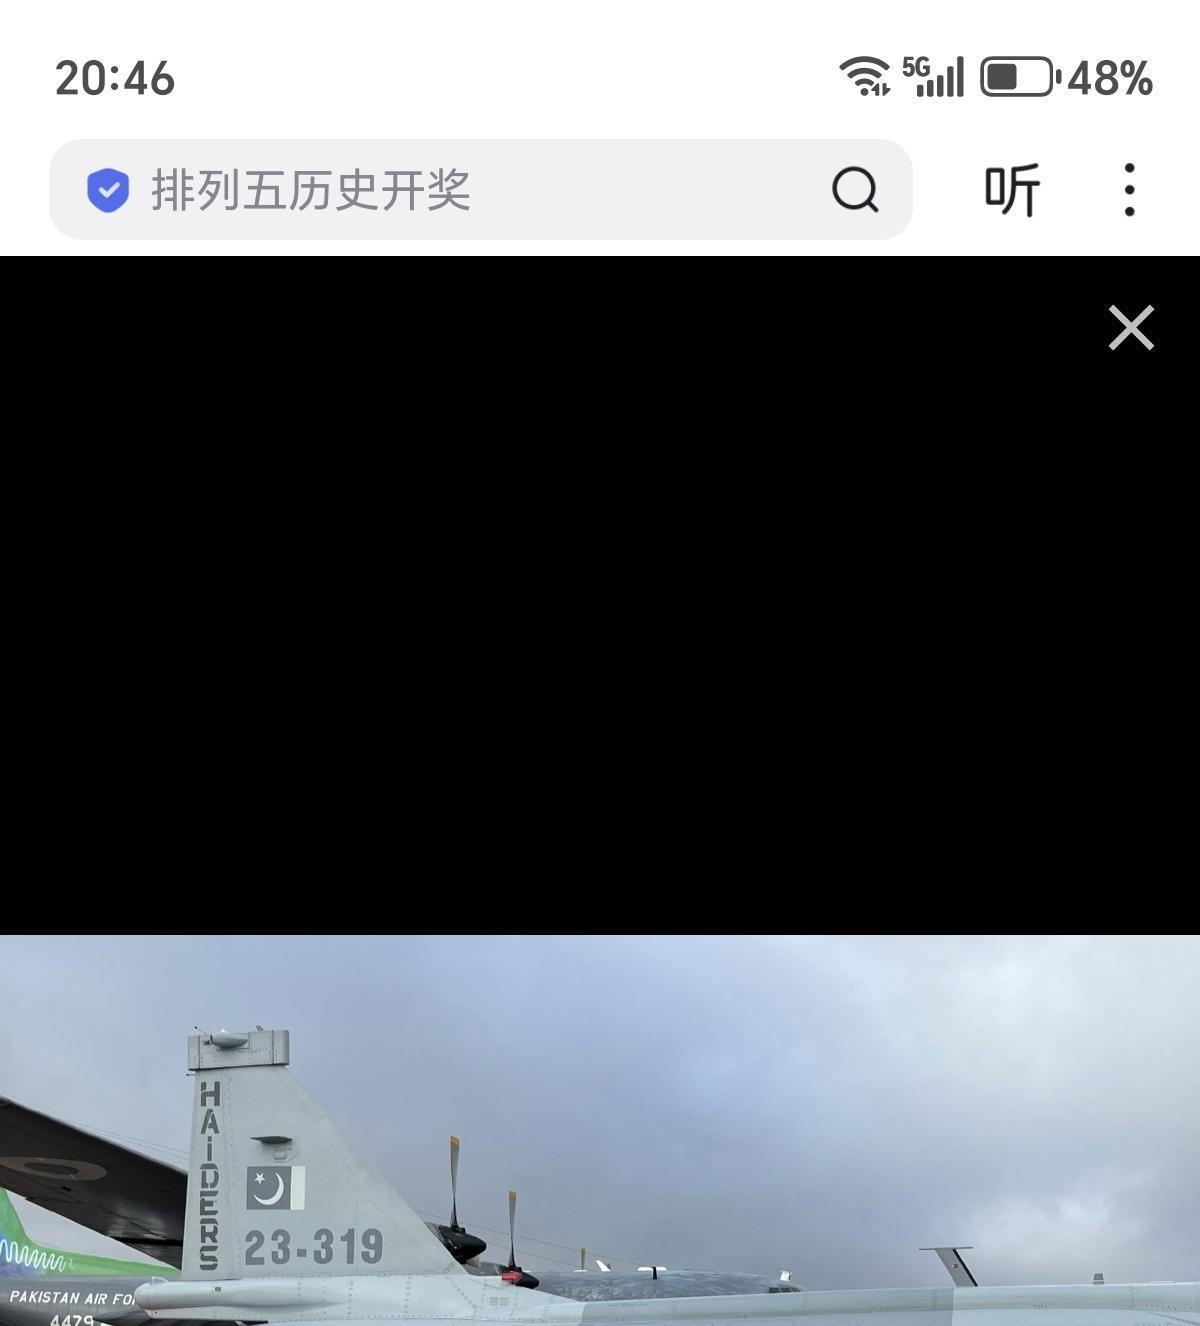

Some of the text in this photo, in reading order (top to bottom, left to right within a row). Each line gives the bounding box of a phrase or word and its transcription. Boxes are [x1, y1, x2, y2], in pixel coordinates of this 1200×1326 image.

[56, 60, 174, 95] 20:46
[902, 56, 931, 77] 5G
[1067, 60, 1154, 96] 48%
[151, 167, 470, 212] 排列五历史开奖
[985, 162, 1041, 218] 听
[245, 1228, 383, 1265] 23-319
[9, 1290, 80, 1304] PAKISTAN
[84, 1293, 108, 1305] AIR
